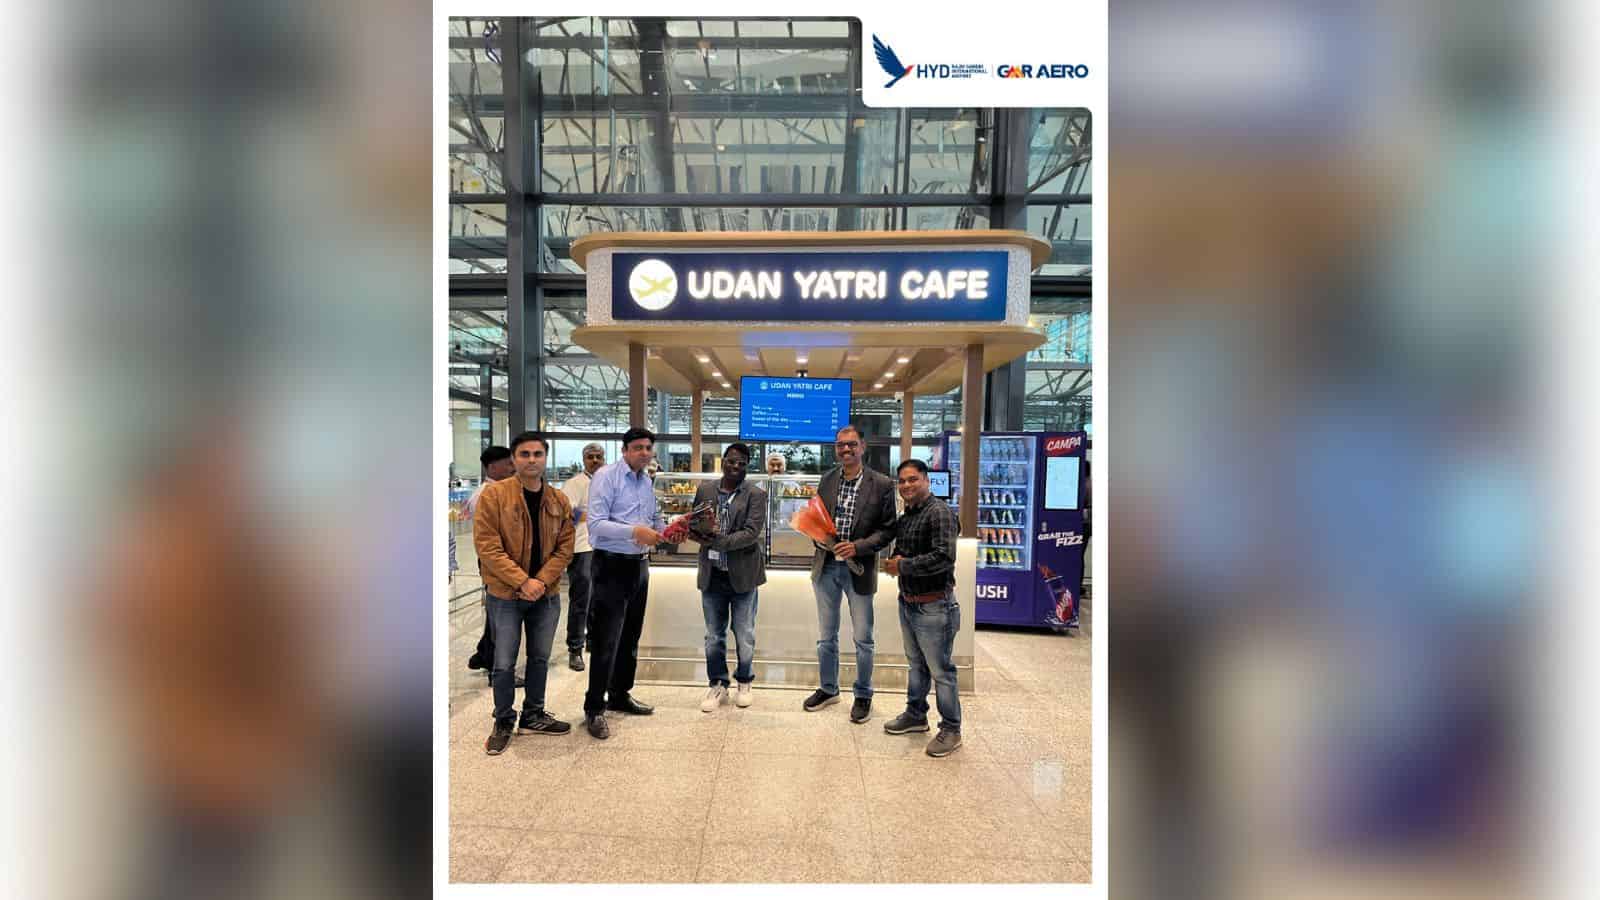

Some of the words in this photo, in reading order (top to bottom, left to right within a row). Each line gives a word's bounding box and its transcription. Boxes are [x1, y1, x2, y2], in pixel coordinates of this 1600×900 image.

[687, 271, 782, 299] UDAN
[793, 271, 887, 299] YATRI
[900, 270, 990, 300] CAFE
[814, 383, 833, 391] CAFE
[1047, 436, 1081, 451] CAMPA
[930, 478, 945, 486] FLY
[1056, 535, 1083, 547] FIZZ
